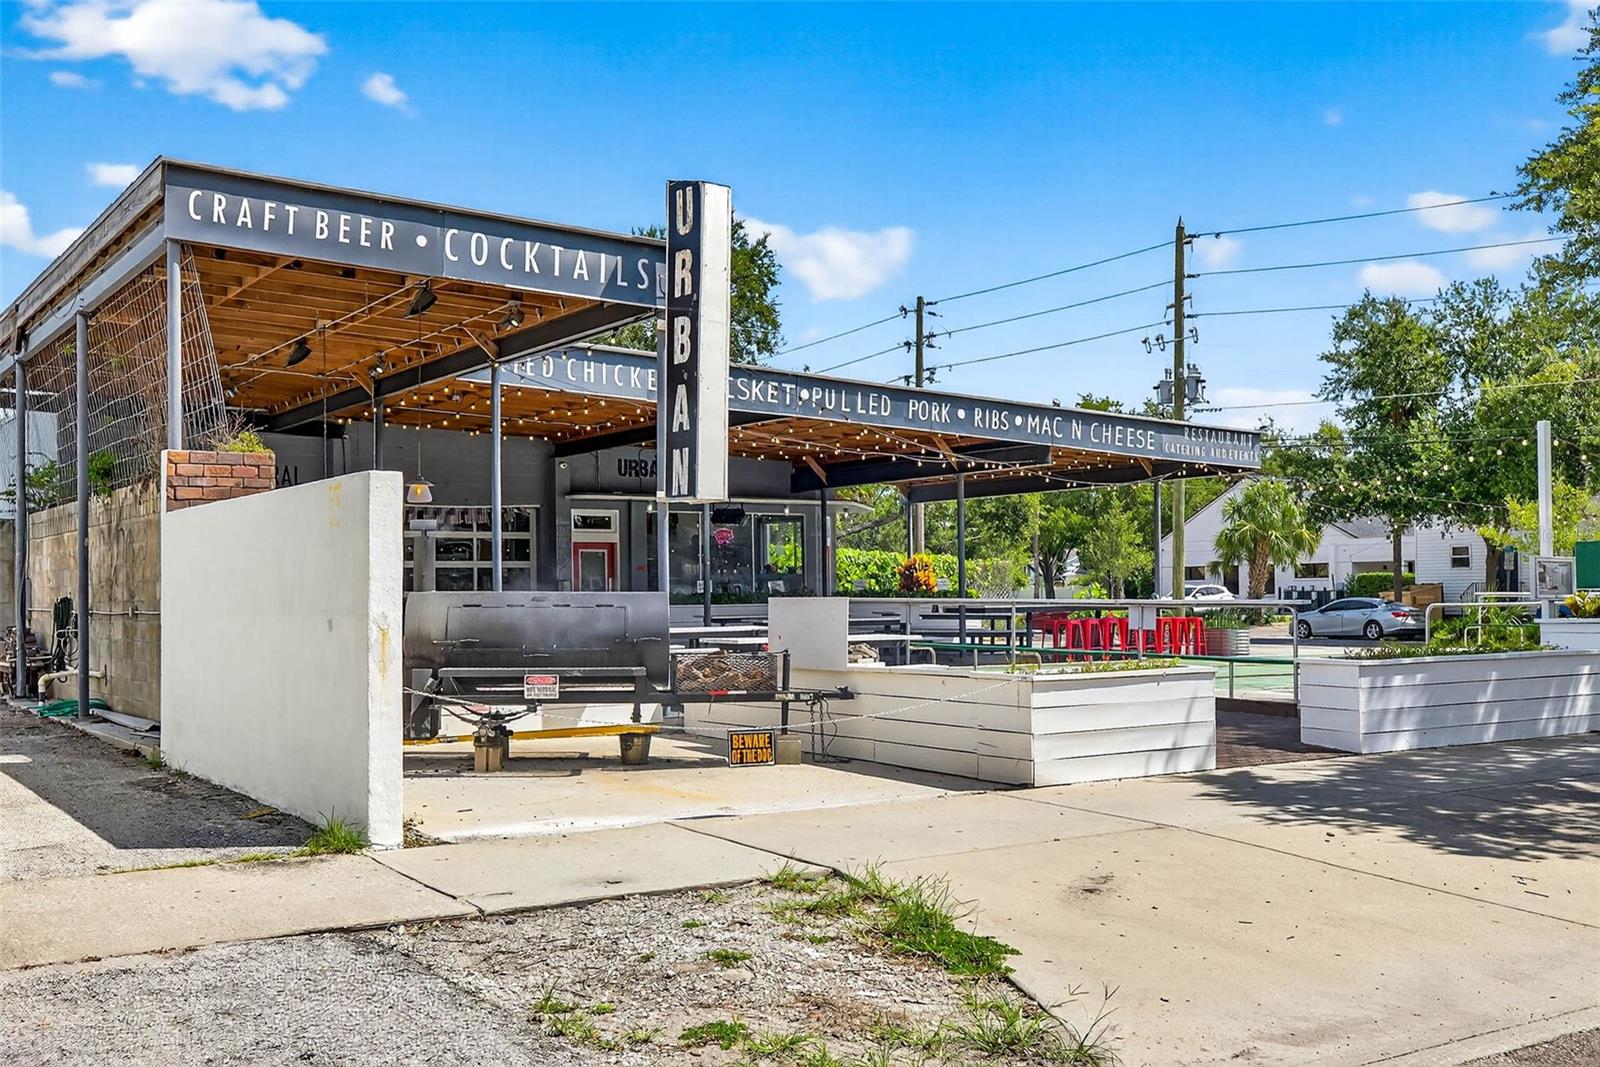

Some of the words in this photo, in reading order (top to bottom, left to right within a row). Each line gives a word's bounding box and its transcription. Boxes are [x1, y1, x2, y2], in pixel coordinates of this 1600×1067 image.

[188, 190, 299, 235] CRAFT
[315, 210, 395, 250] BEER
[444, 229, 650, 290] COCKTAILS
[672, 186, 693, 496] URBAN
[501, 355, 554, 378] IED
[567, 358, 657, 391] CHICKE
[812, 387, 891, 416] PULLED
[908, 399, 951, 424] PORK
[974, 408, 1009, 431] RIBS
[1027, 414, 1063, 438] MAC
[1071, 419, 1082, 440] N
[1090, 423, 1156, 450] CHEESE
[1184, 427, 1253, 449] RESTAURANT
[1165, 443, 1206, 458] CATERING
[1210, 447, 1228, 460] AND
[1229, 450, 1260, 463] EVENTS
[617, 458, 657, 478] URBA
[732, 734, 771, 749] BEWARE
[732, 750, 741, 764] OF
[742, 749, 757, 763] THE
[757, 748, 773, 762] DOG
